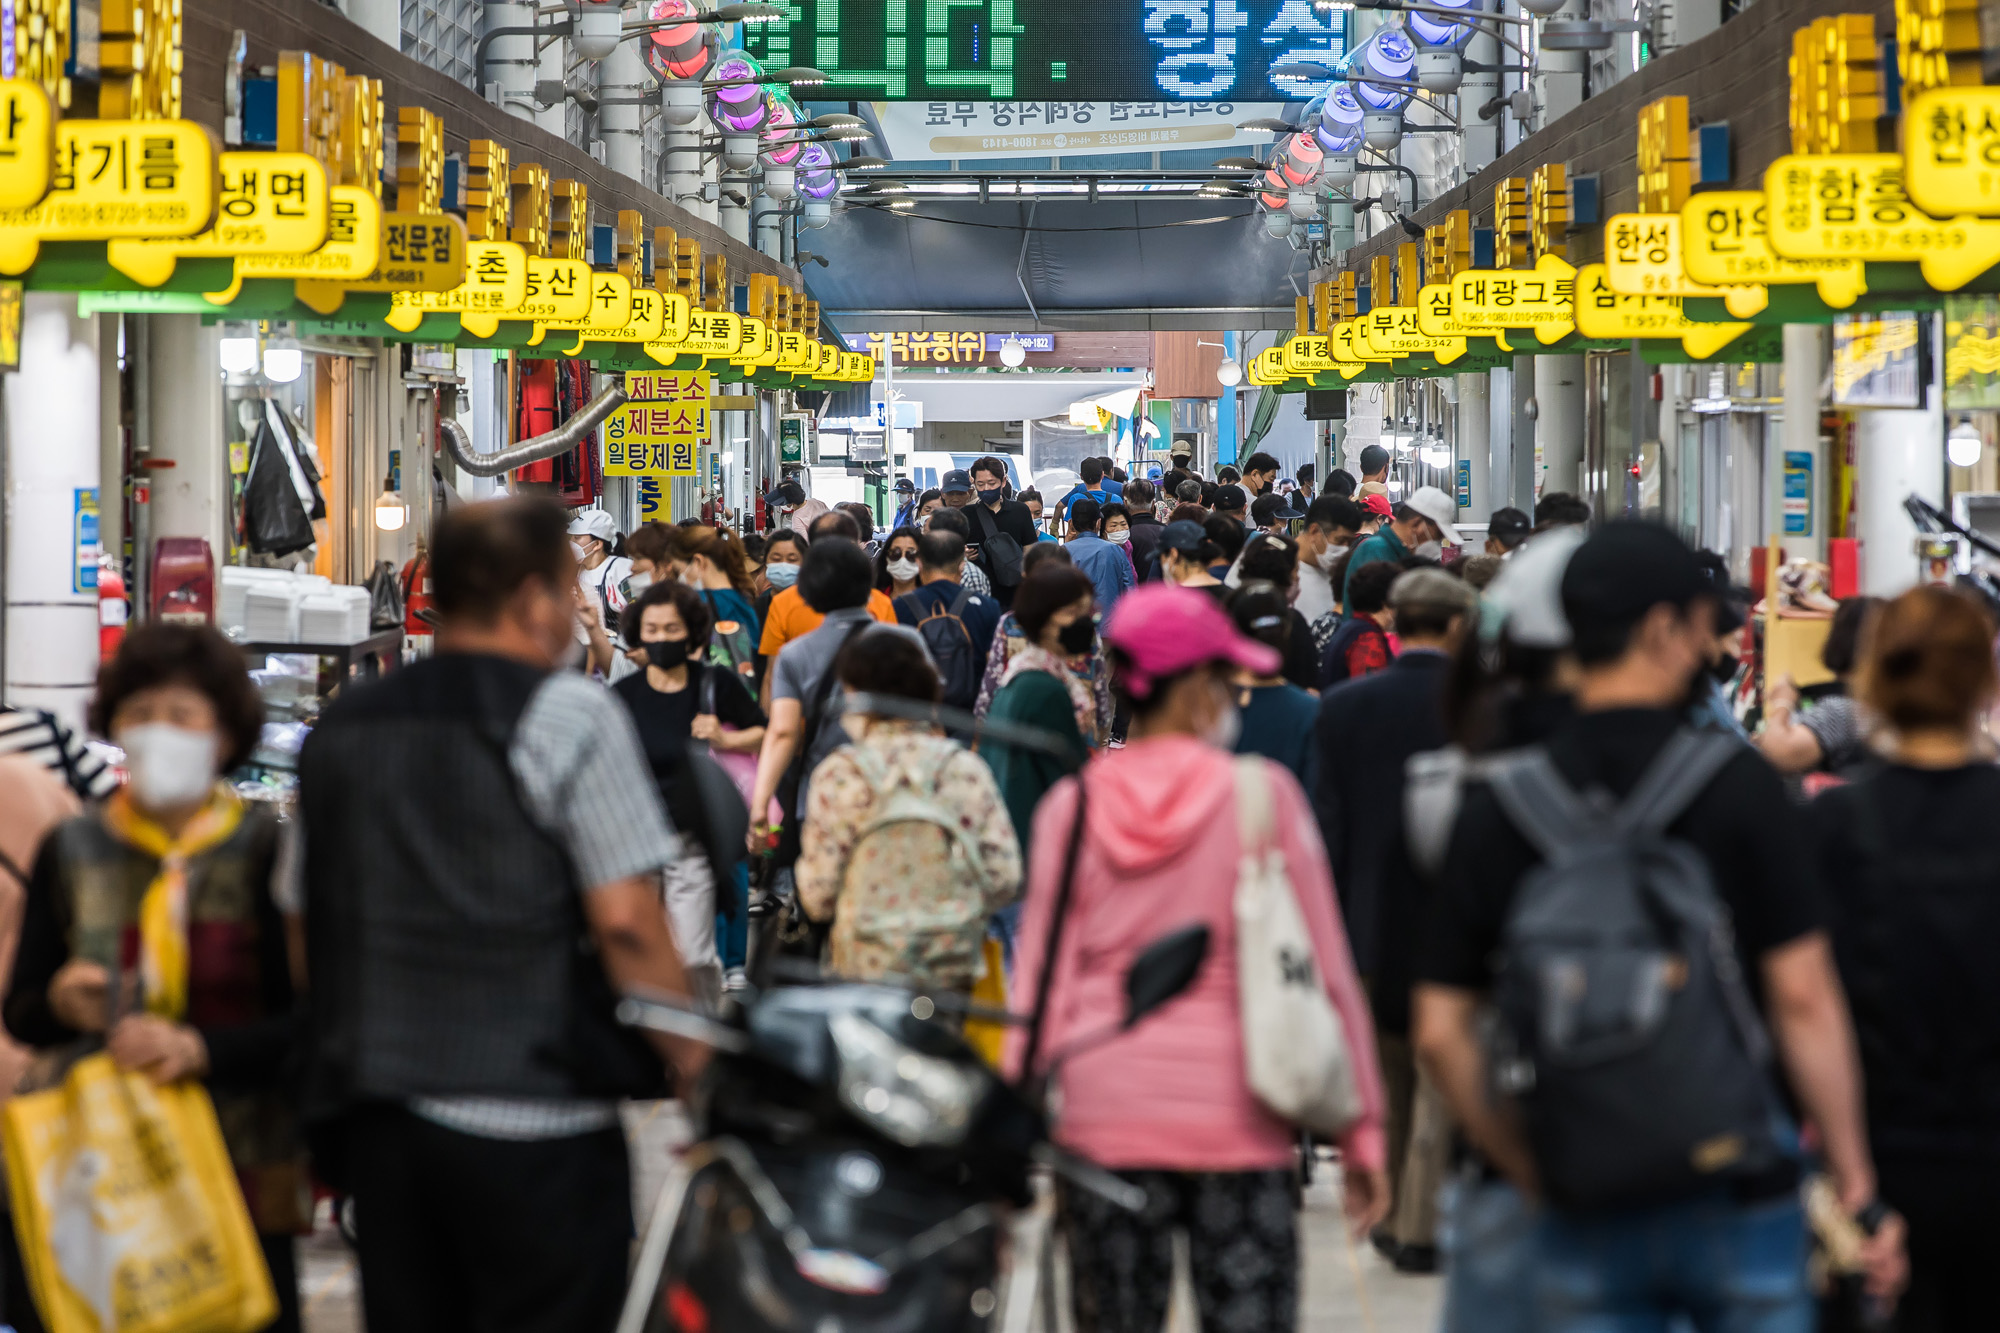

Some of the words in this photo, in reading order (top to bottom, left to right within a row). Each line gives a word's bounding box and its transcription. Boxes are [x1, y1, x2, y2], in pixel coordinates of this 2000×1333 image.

[222, 171, 306, 216] 냉면
[1819, 169, 1906, 222] 함흥
[387, 224, 450, 262] 전문점
[1617, 224, 1668, 263] 한성
[477, 251, 508, 283] 촌
[596, 282, 618, 308] 수
[1463, 279, 1573, 306] 대광그릇
[632, 297, 653, 322] 맛
[580, 328, 636, 337] 8205-2763
[690, 317, 731, 339] 식품
[1374, 314, 1417, 336] 부산
[780, 336, 799, 353] 국
[1296, 341, 1328, 357] 태경
[1391, 339, 1452, 348] T.960-3342
[1270, 352, 1282, 365] 대
[631, 376, 706, 401] 제분소
[628, 408, 692, 436] 제분소
[608, 416, 625, 465] 성일
[628, 443, 692, 470] 탕제원
